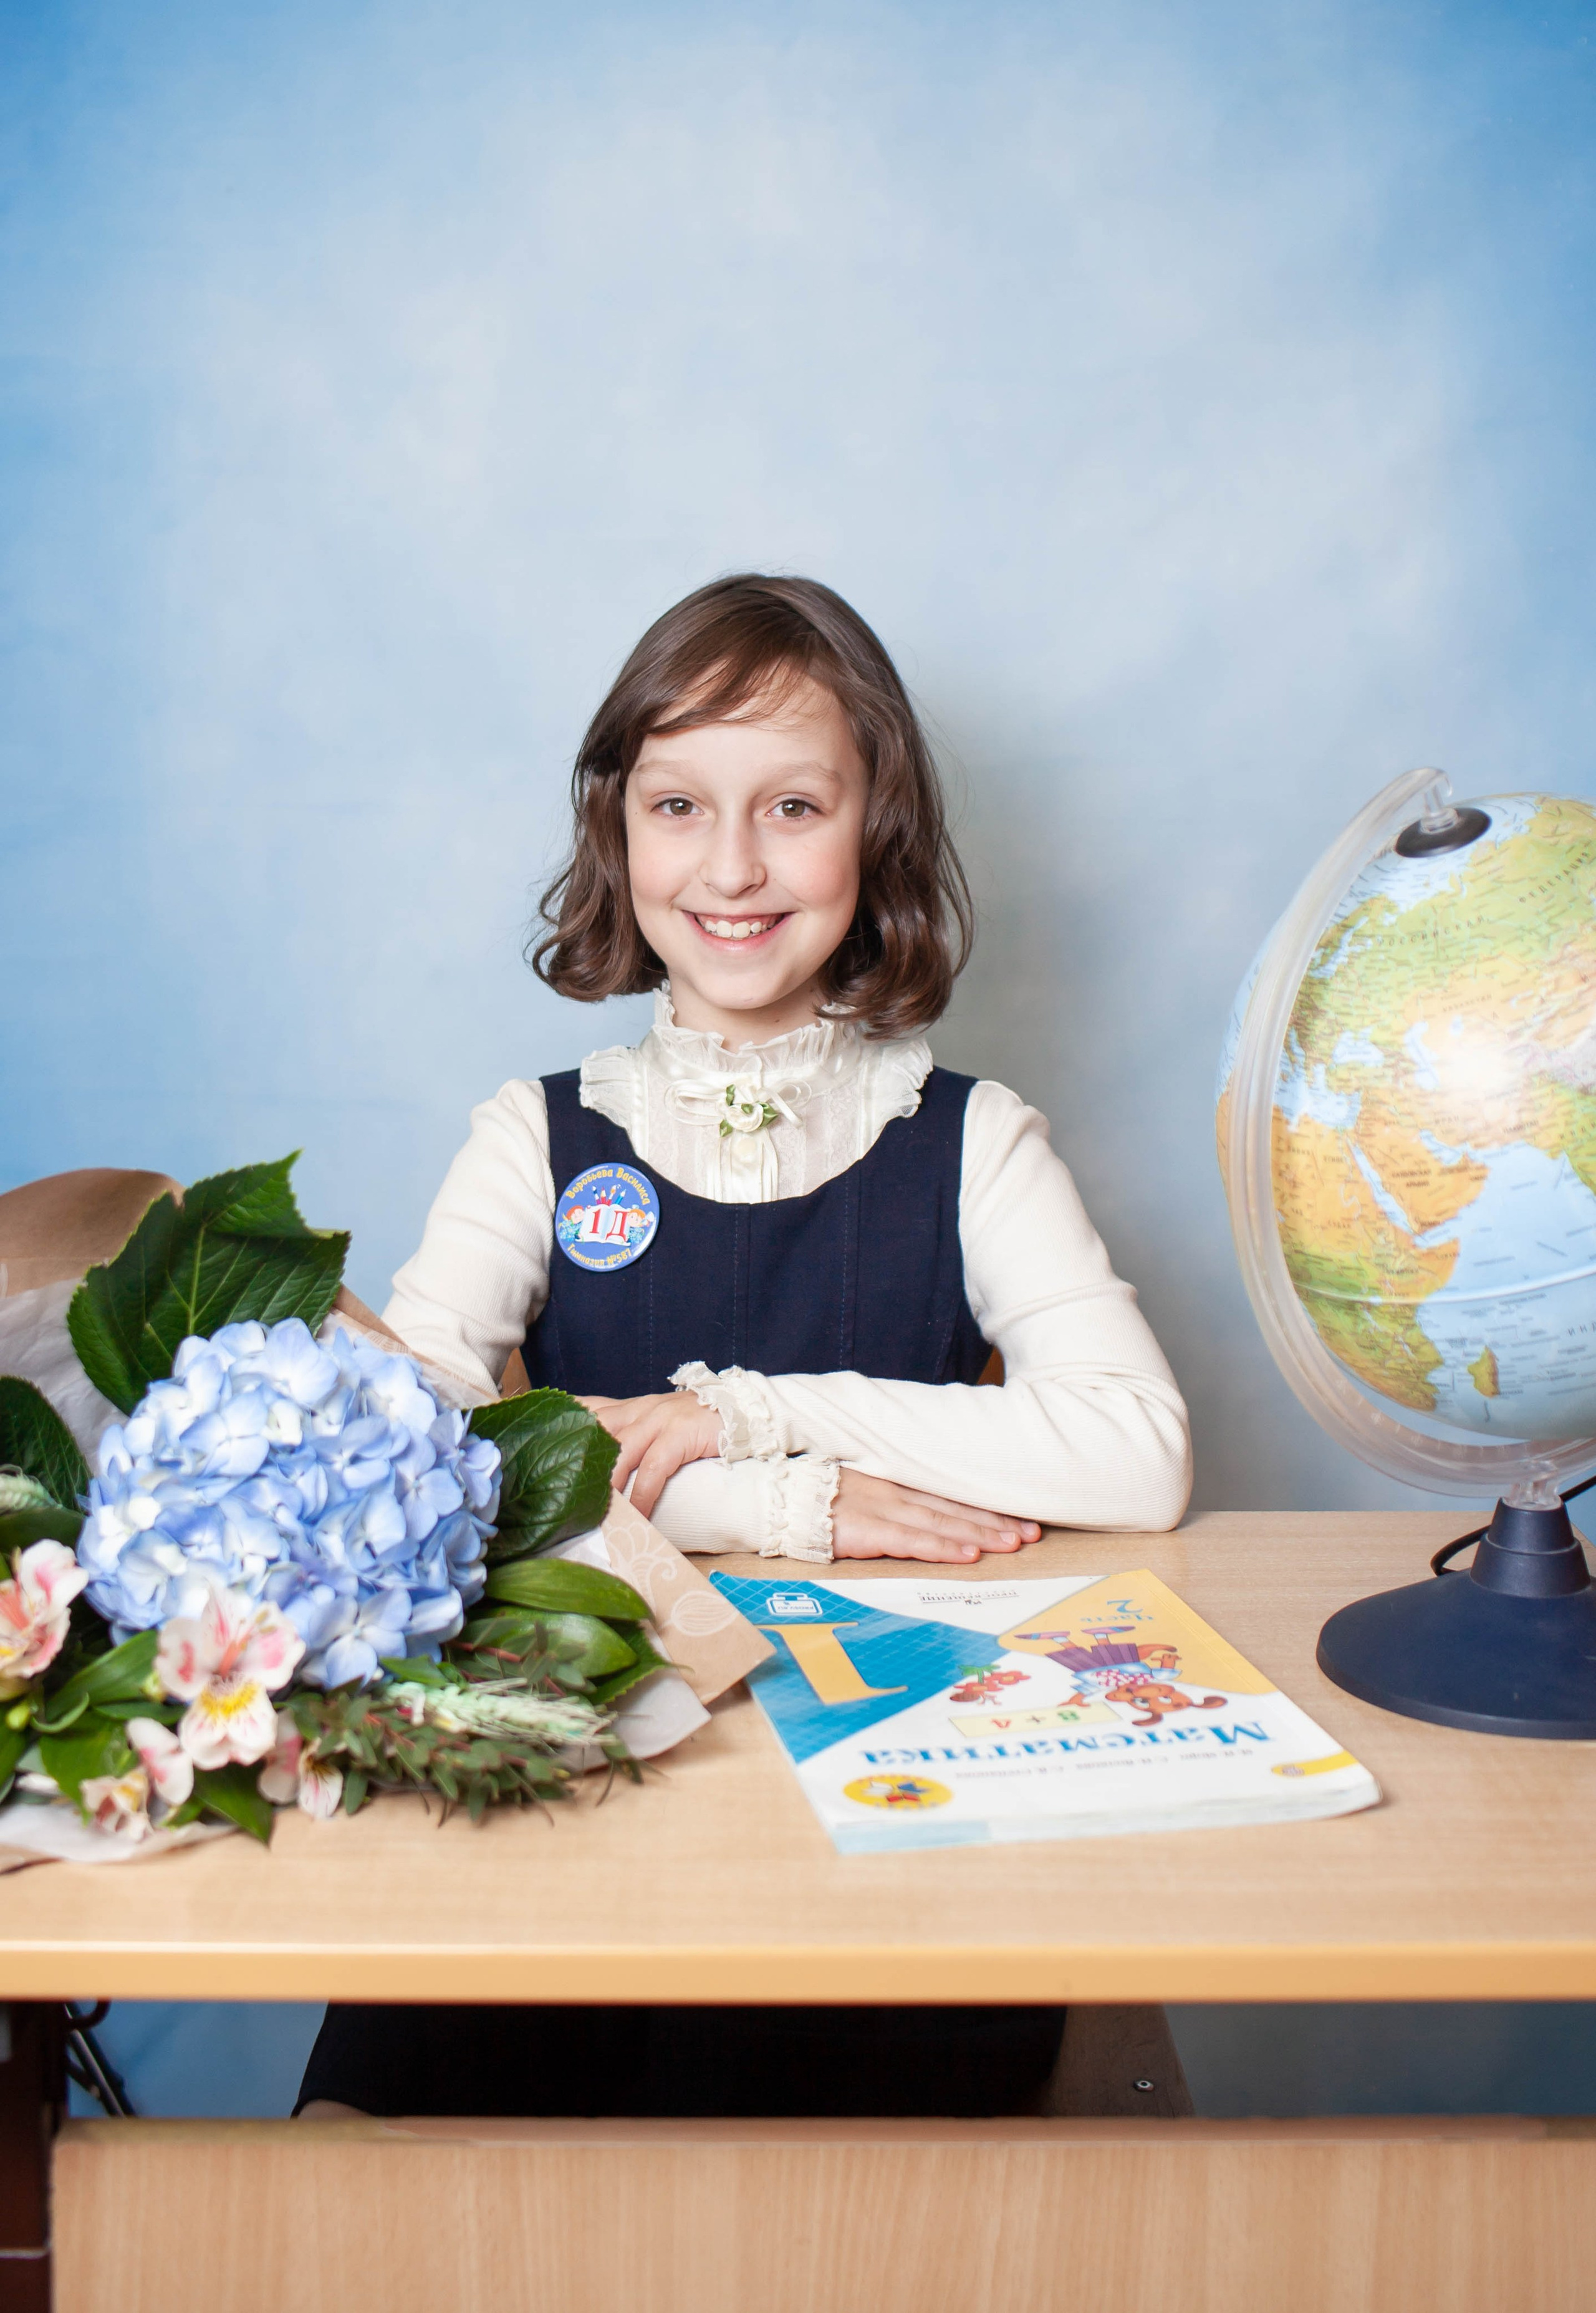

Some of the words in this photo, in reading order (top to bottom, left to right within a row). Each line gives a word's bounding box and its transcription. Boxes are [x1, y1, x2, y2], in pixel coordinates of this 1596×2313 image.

[565, 1168, 613, 1199] Воробьева
[616, 1167, 651, 1205] Василиса
[567, 1243, 605, 1267] Гимназия
[1107, 1599, 1143, 1614] 2
[752, 1622, 909, 1706] 1
[862, 1721, 1274, 1765] Математика
